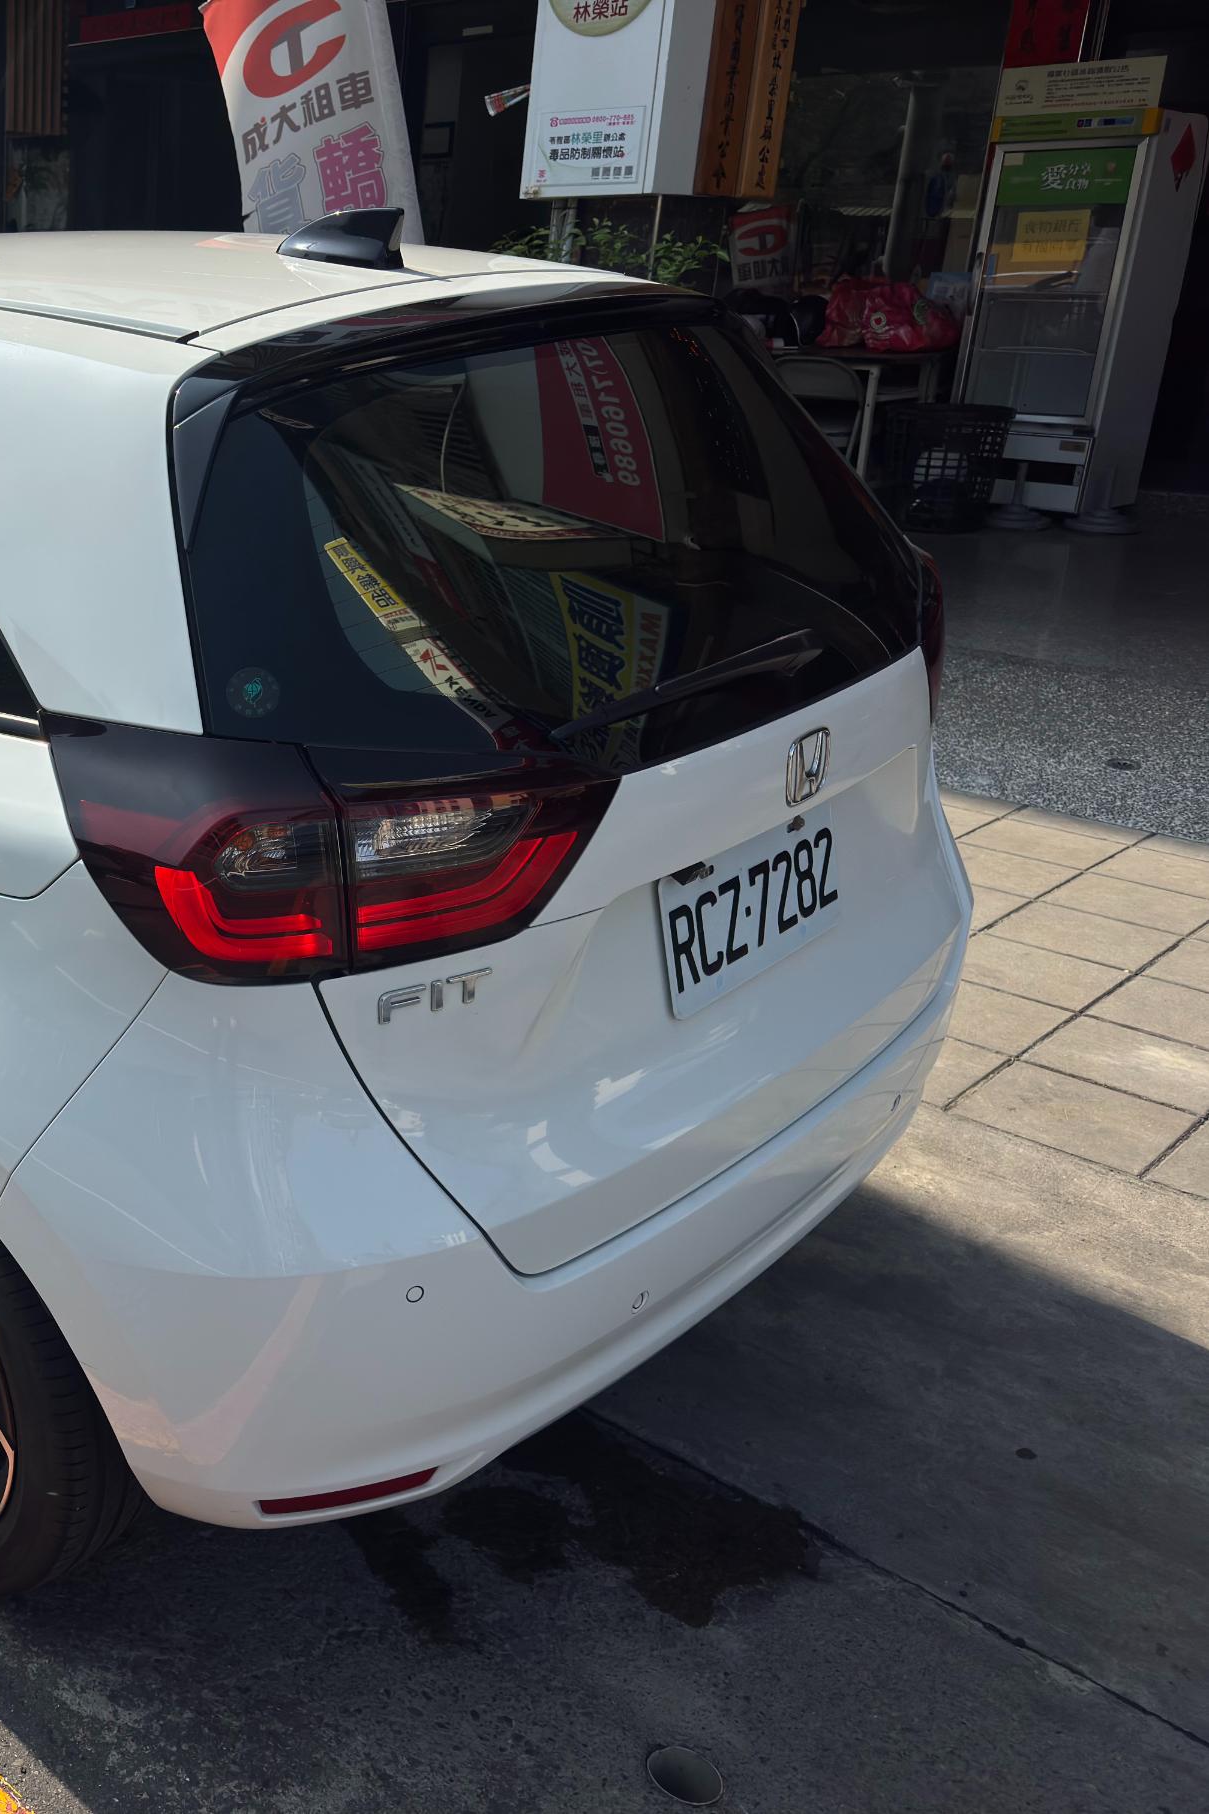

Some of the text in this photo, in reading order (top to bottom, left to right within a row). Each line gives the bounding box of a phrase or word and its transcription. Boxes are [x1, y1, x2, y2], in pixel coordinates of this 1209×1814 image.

[573, 0, 628, 23] 林榮站
[241, 70, 375, 165] 成大租車
[1041, 163, 1068, 190] 愛
[378, 967, 493, 1025] FIT
